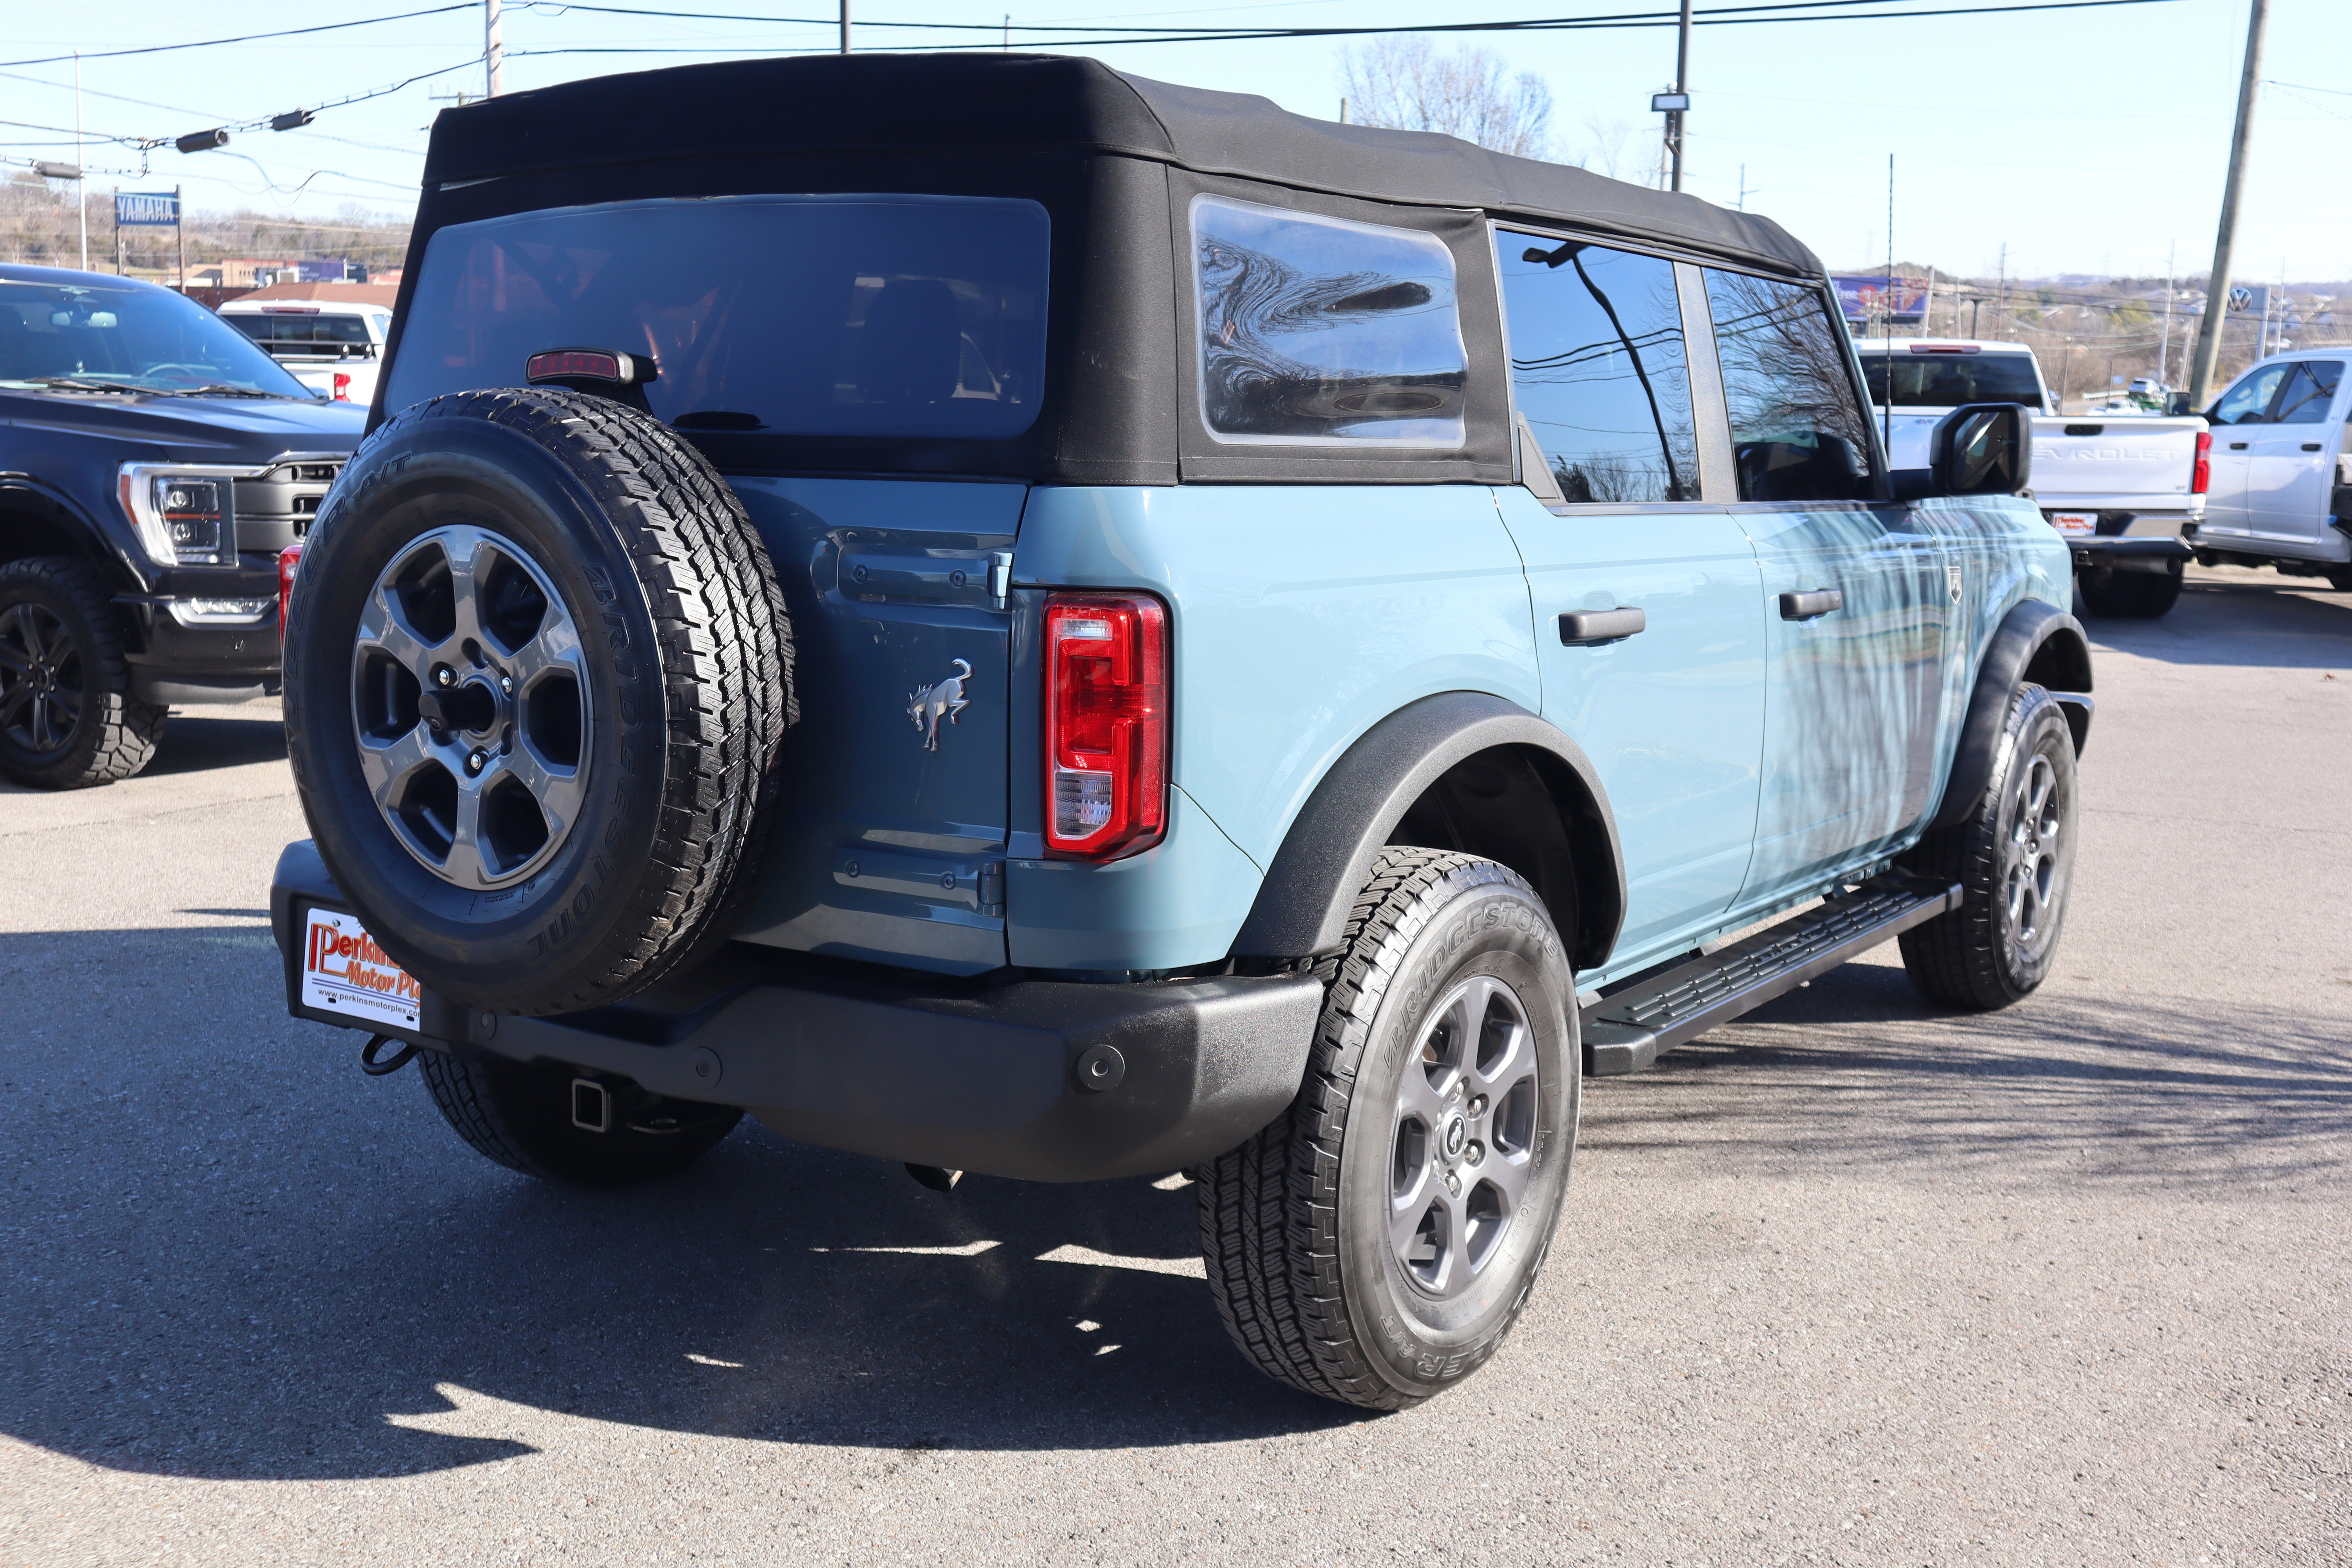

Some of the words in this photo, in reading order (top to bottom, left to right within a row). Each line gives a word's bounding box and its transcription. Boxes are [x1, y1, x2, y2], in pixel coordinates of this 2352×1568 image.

[117, 196, 174, 221] YAMAHA
[2032, 448, 2181, 461] EVROLET
[283, 494, 347, 791] DUELER
[359, 451, 412, 498] A/T
[527, 563, 644, 964] BRIDGESTONE
[308, 923, 401, 971] Perki
[347, 960, 396, 992] Motor
[396, 970, 421, 1000] Pl
[1382, 901, 1559, 1078] BRIDGESTONE
[1379, 1315, 1417, 1359] A/T
